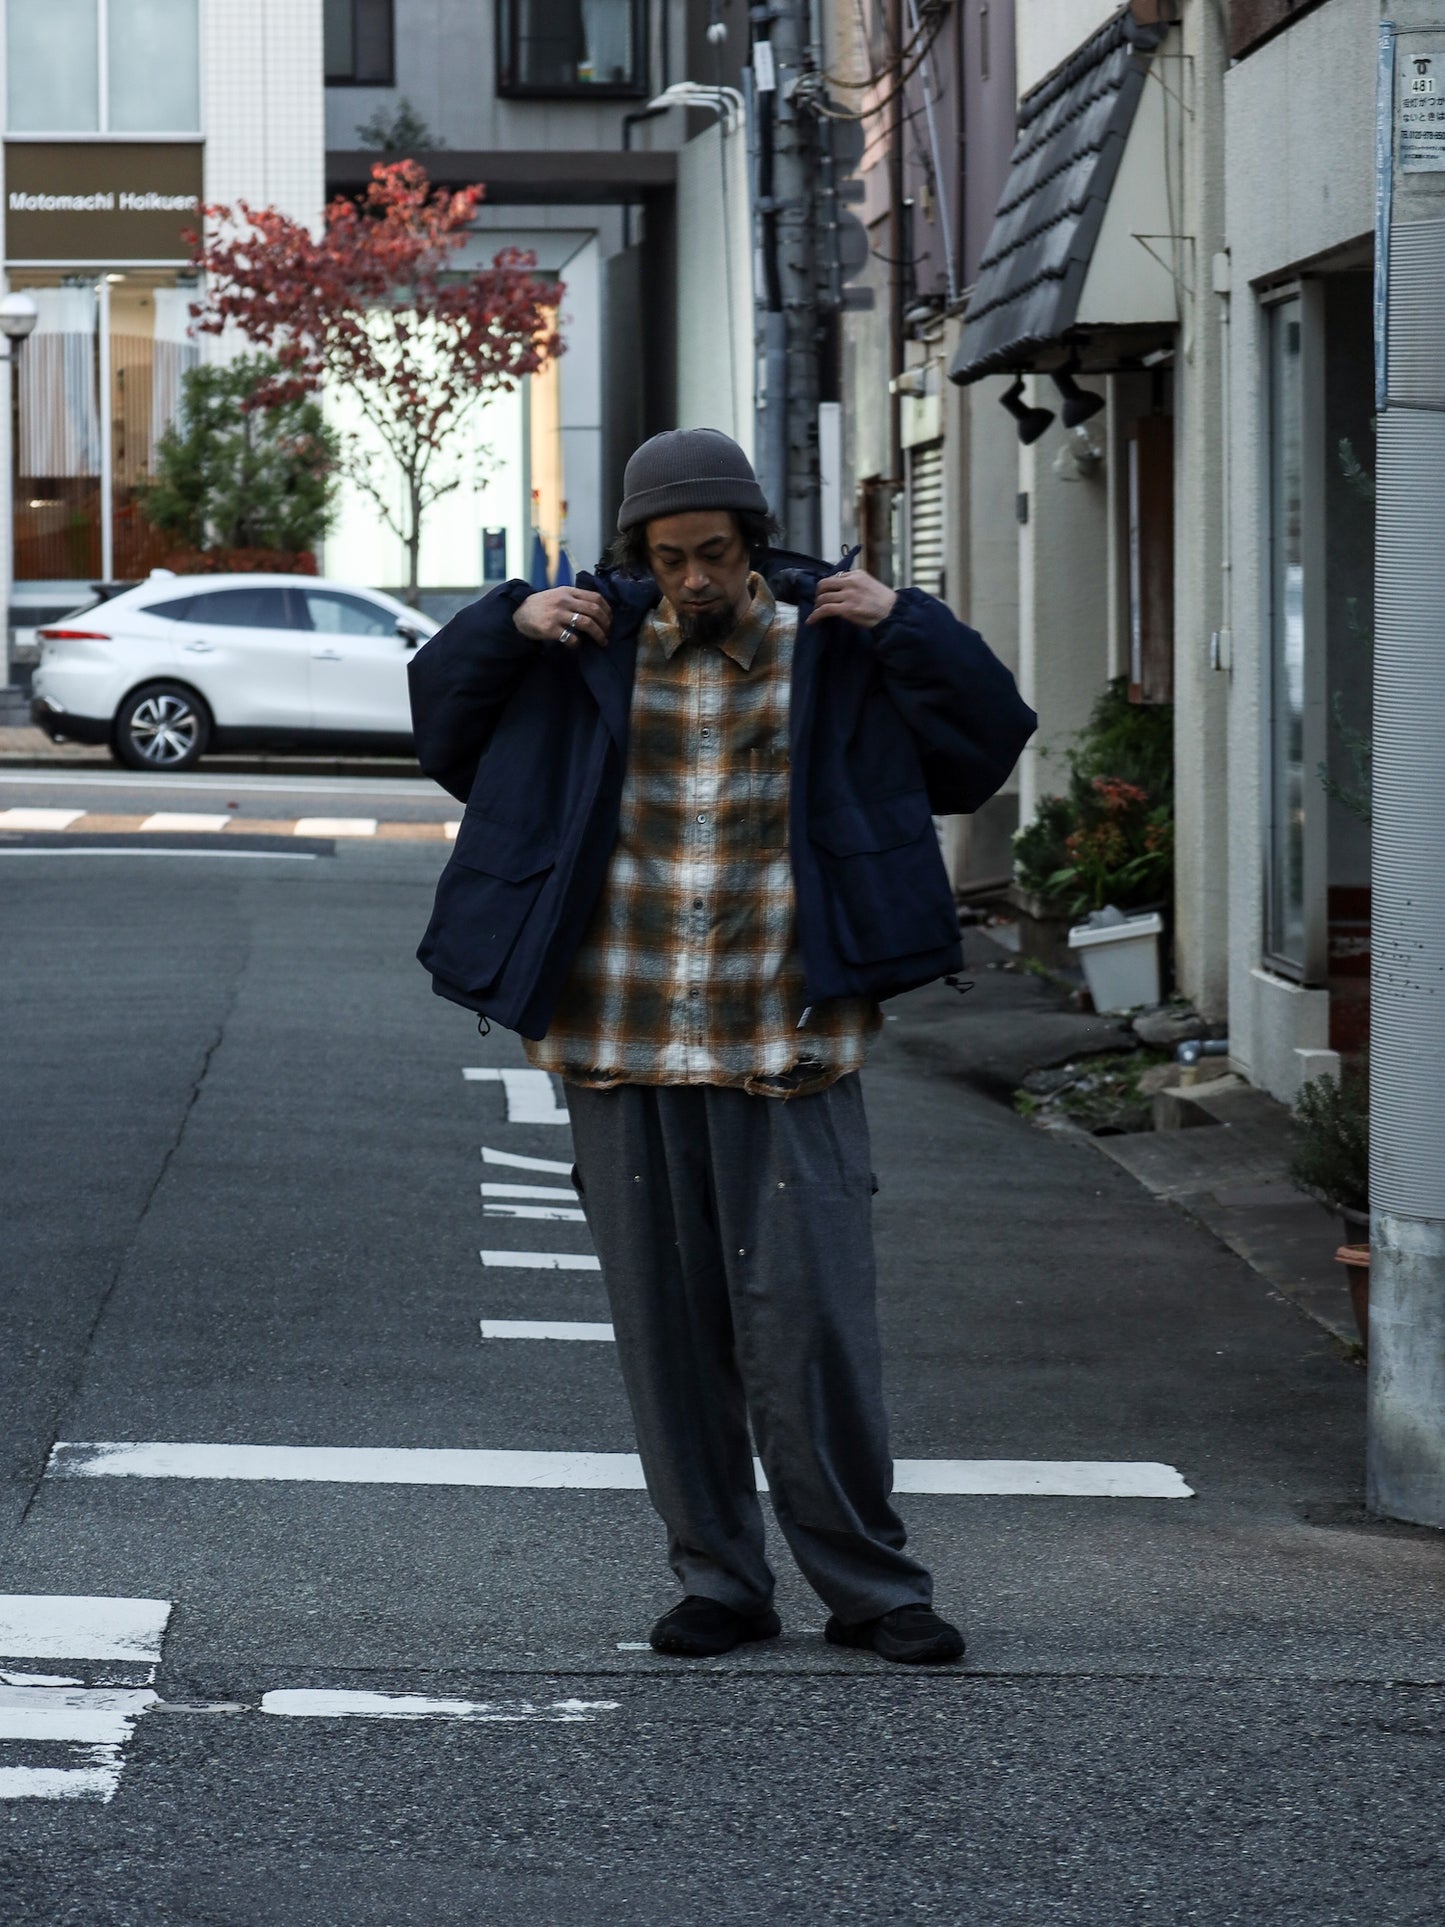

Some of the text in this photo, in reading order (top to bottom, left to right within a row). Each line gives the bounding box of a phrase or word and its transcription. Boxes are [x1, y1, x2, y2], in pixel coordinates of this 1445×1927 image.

[1412, 80, 1432, 91] 481
[9, 192, 198, 210] Motomachi Hoikuen
